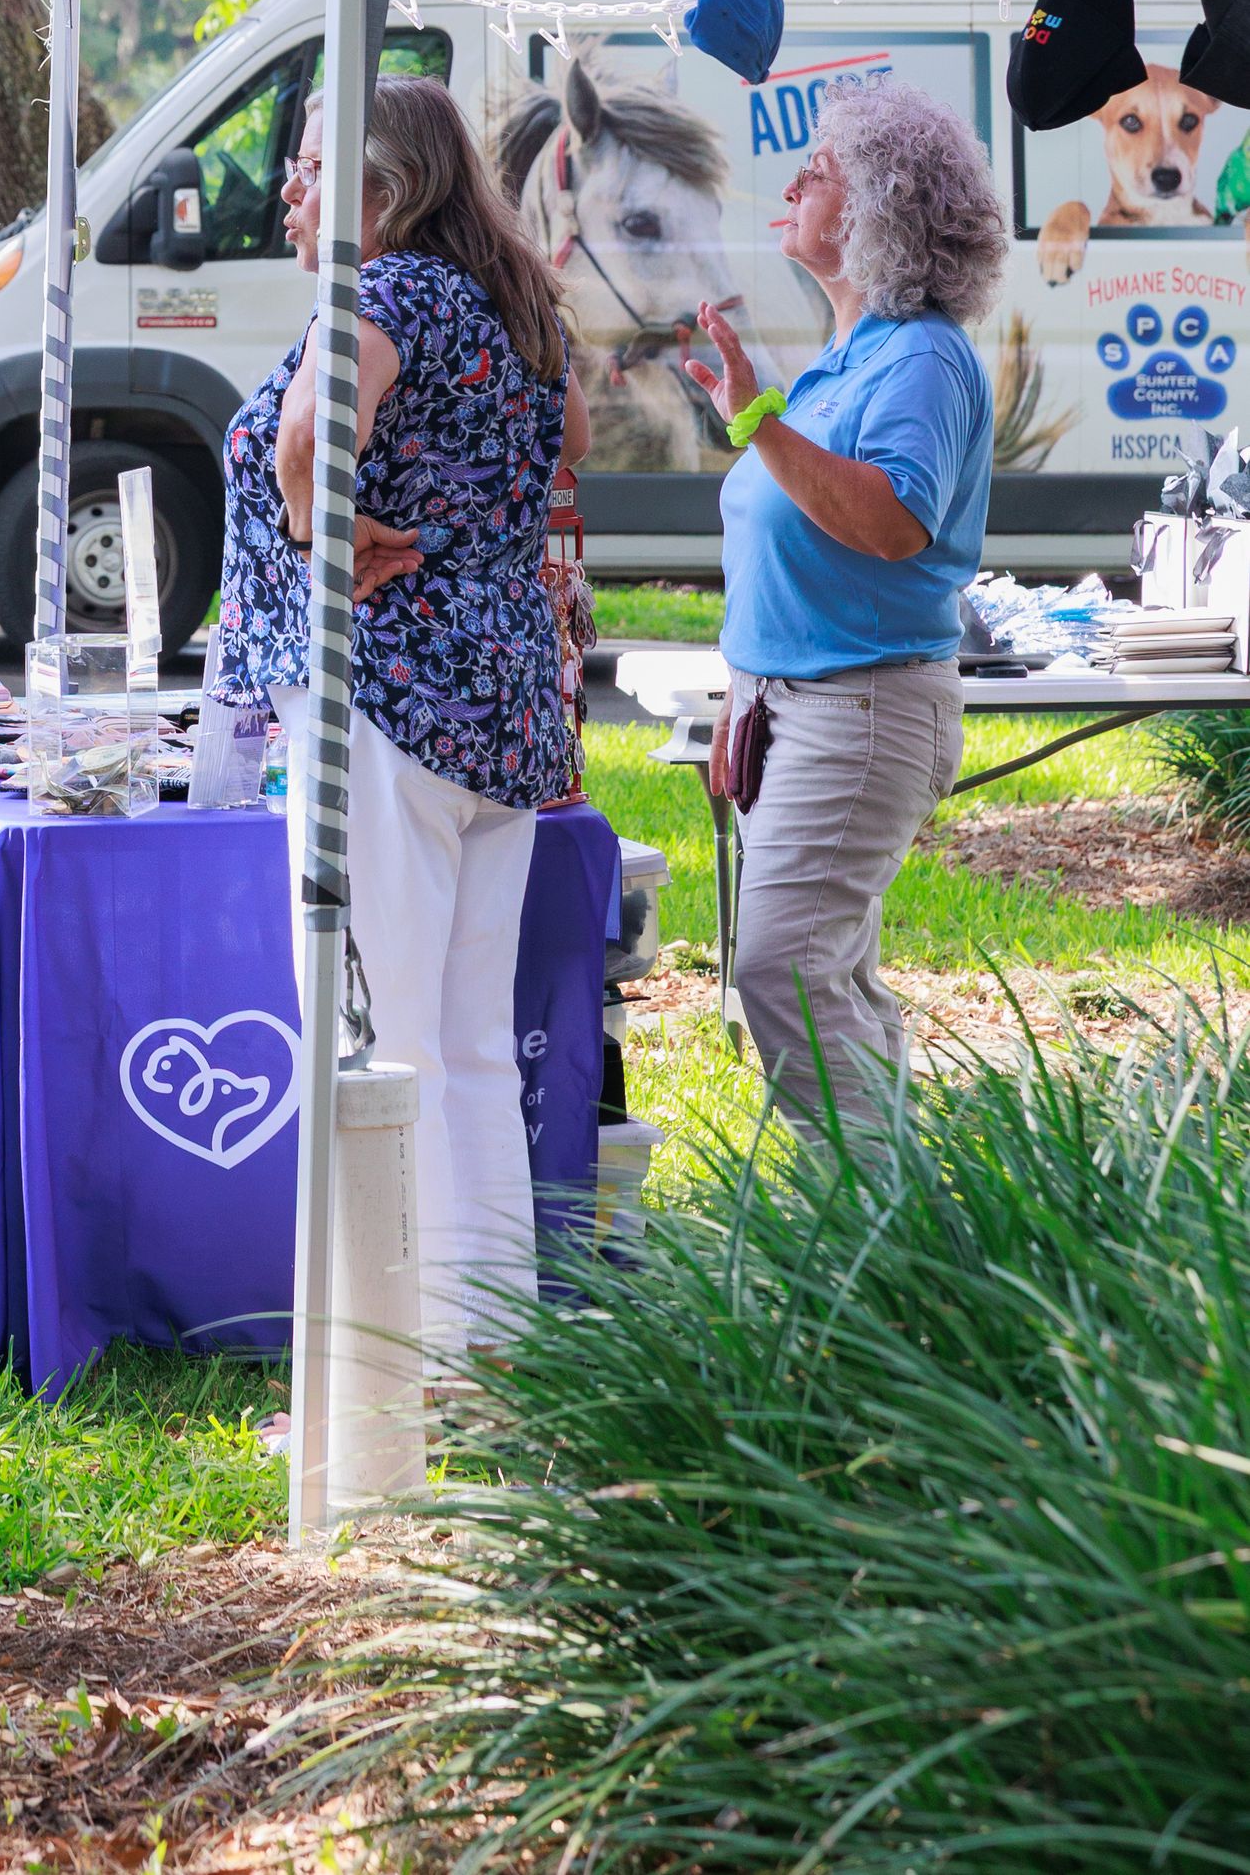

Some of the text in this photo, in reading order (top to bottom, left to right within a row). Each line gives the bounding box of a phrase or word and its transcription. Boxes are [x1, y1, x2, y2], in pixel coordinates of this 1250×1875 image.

[1088, 267, 1247, 307] HUMANE SOCIETY
[1155, 361, 1177, 374] OF
[1136, 374, 1198, 388] SUMTER
[1133, 388, 1200, 402] COUNTY,
[1151, 403, 1183, 416] INC.
[1111, 434, 1225, 460] HSSPCA
[552, 491, 572, 505] HONE
[526, 1087, 546, 1107] of
